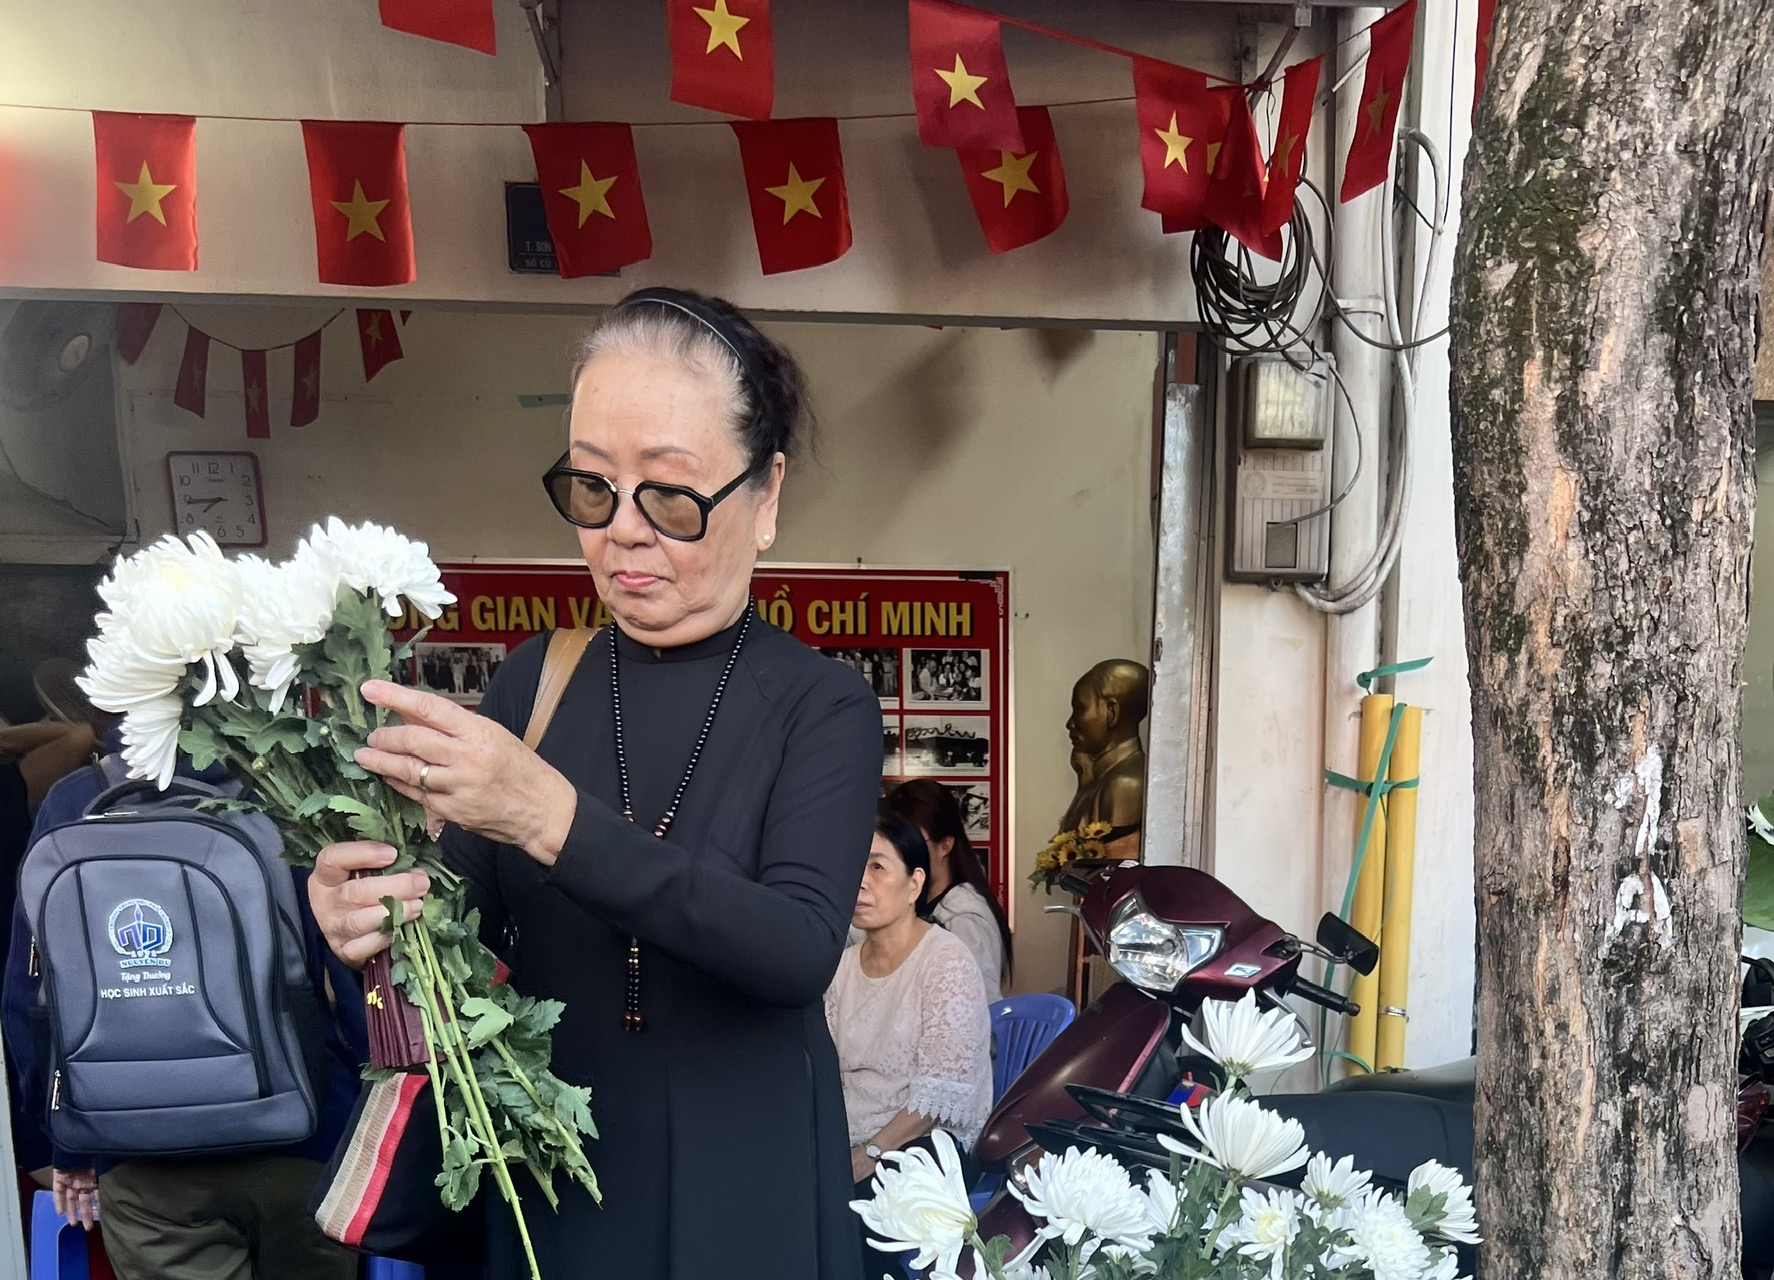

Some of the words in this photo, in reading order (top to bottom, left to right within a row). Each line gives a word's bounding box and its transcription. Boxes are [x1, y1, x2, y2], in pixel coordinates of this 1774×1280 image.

[208, 462, 219, 474] 12
[241, 475, 251, 486] 2
[245, 494, 253, 506] 3
[247, 513, 255, 524] 4
[217, 526, 226, 538] 6
[236, 525, 244, 538] 5
[471, 595, 556, 631] GIAN
[807, 592, 869, 635] CHÍ
[881, 601, 971, 637] MINH
[100, 988, 122, 1000] HỌC
[123, 987, 147, 998] SINH
[149, 983, 174, 996] XUẤT
[176, 981, 195, 995] SẮC
